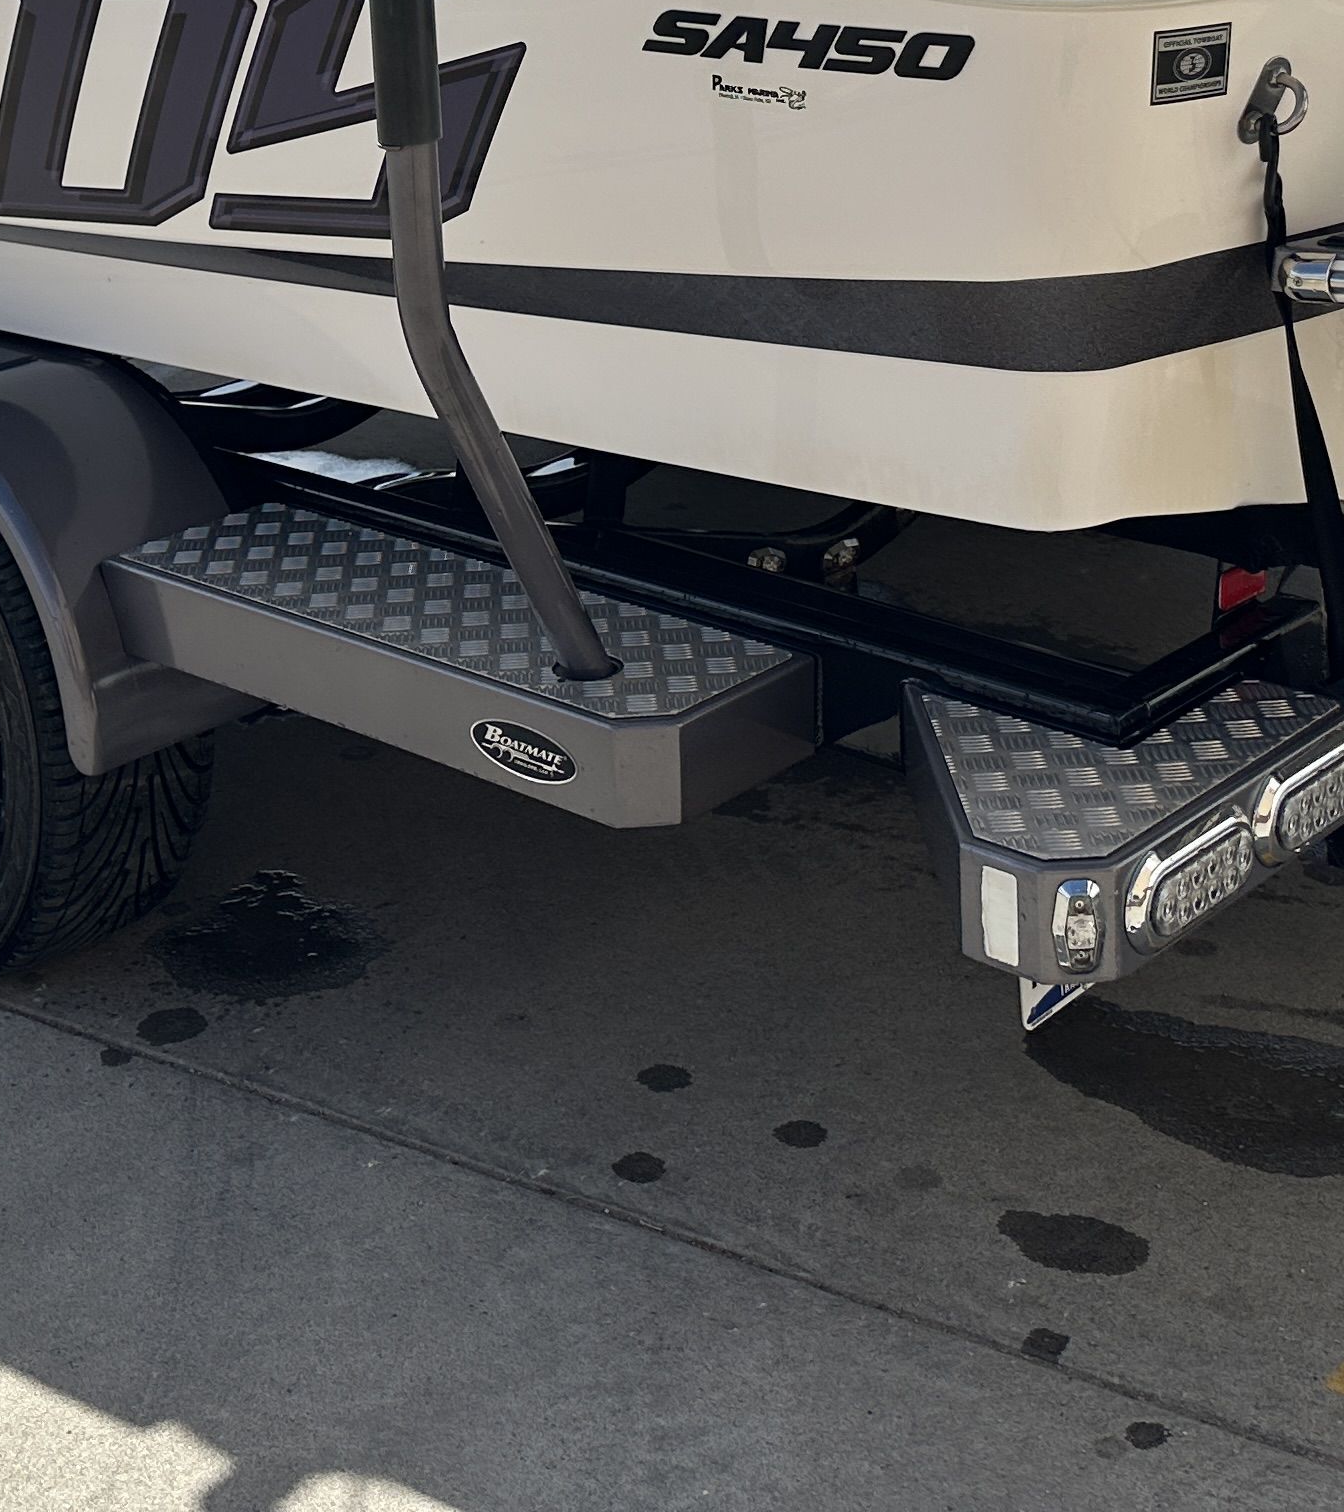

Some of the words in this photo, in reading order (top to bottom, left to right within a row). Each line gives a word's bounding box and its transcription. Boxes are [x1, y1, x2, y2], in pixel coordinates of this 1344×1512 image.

[642, 9, 975, 81] SA450
[1163, 39, 1193, 49] OFFICIAL
[484, 723, 565, 766] BOATMATE
